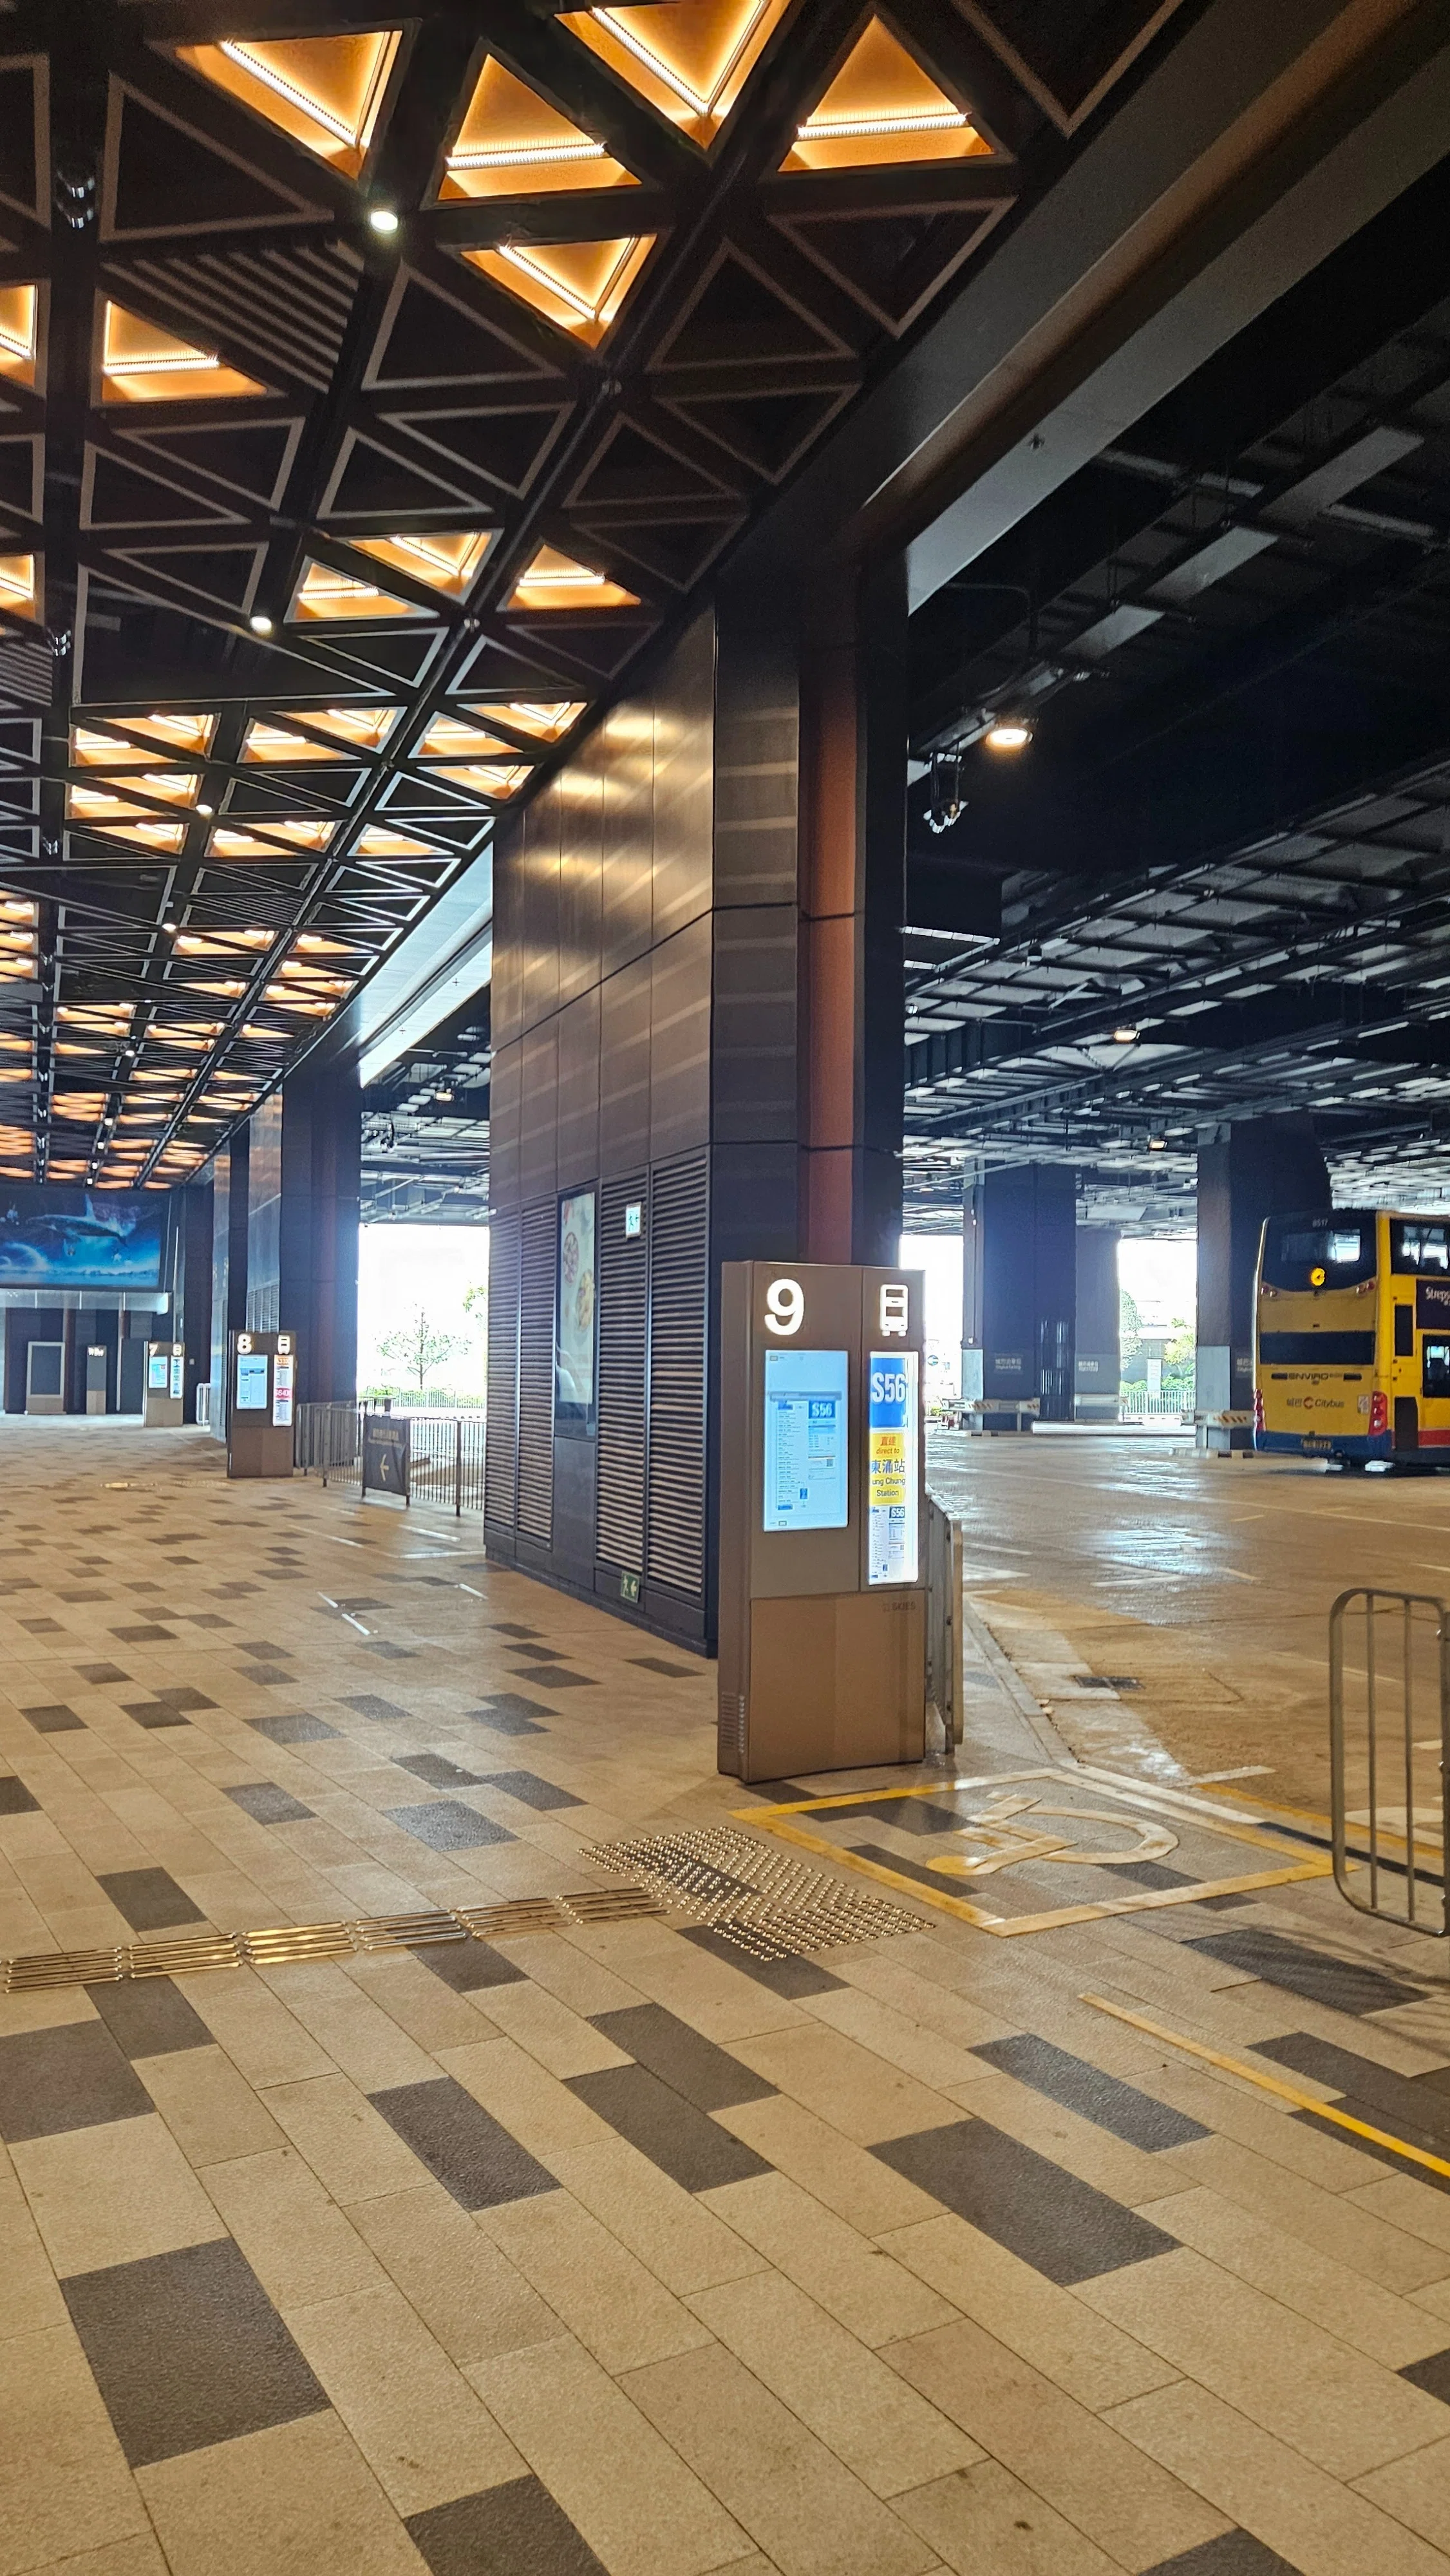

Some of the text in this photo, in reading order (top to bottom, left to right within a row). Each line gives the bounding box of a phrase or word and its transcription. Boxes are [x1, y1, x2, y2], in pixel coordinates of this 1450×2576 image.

[764, 1278, 804, 1336] 9
[149, 1343, 158, 1357] 7
[237, 1333, 252, 1354] 8
[871, 1372, 906, 1403] S56
[811, 1402, 832, 1417] S56
[1315, 1399, 1344, 1409] Citybus
[871, 1459, 905, 1473] 東涌站
[885, 1477, 905, 1486] Chung
[890, 1508, 905, 1517] S56
